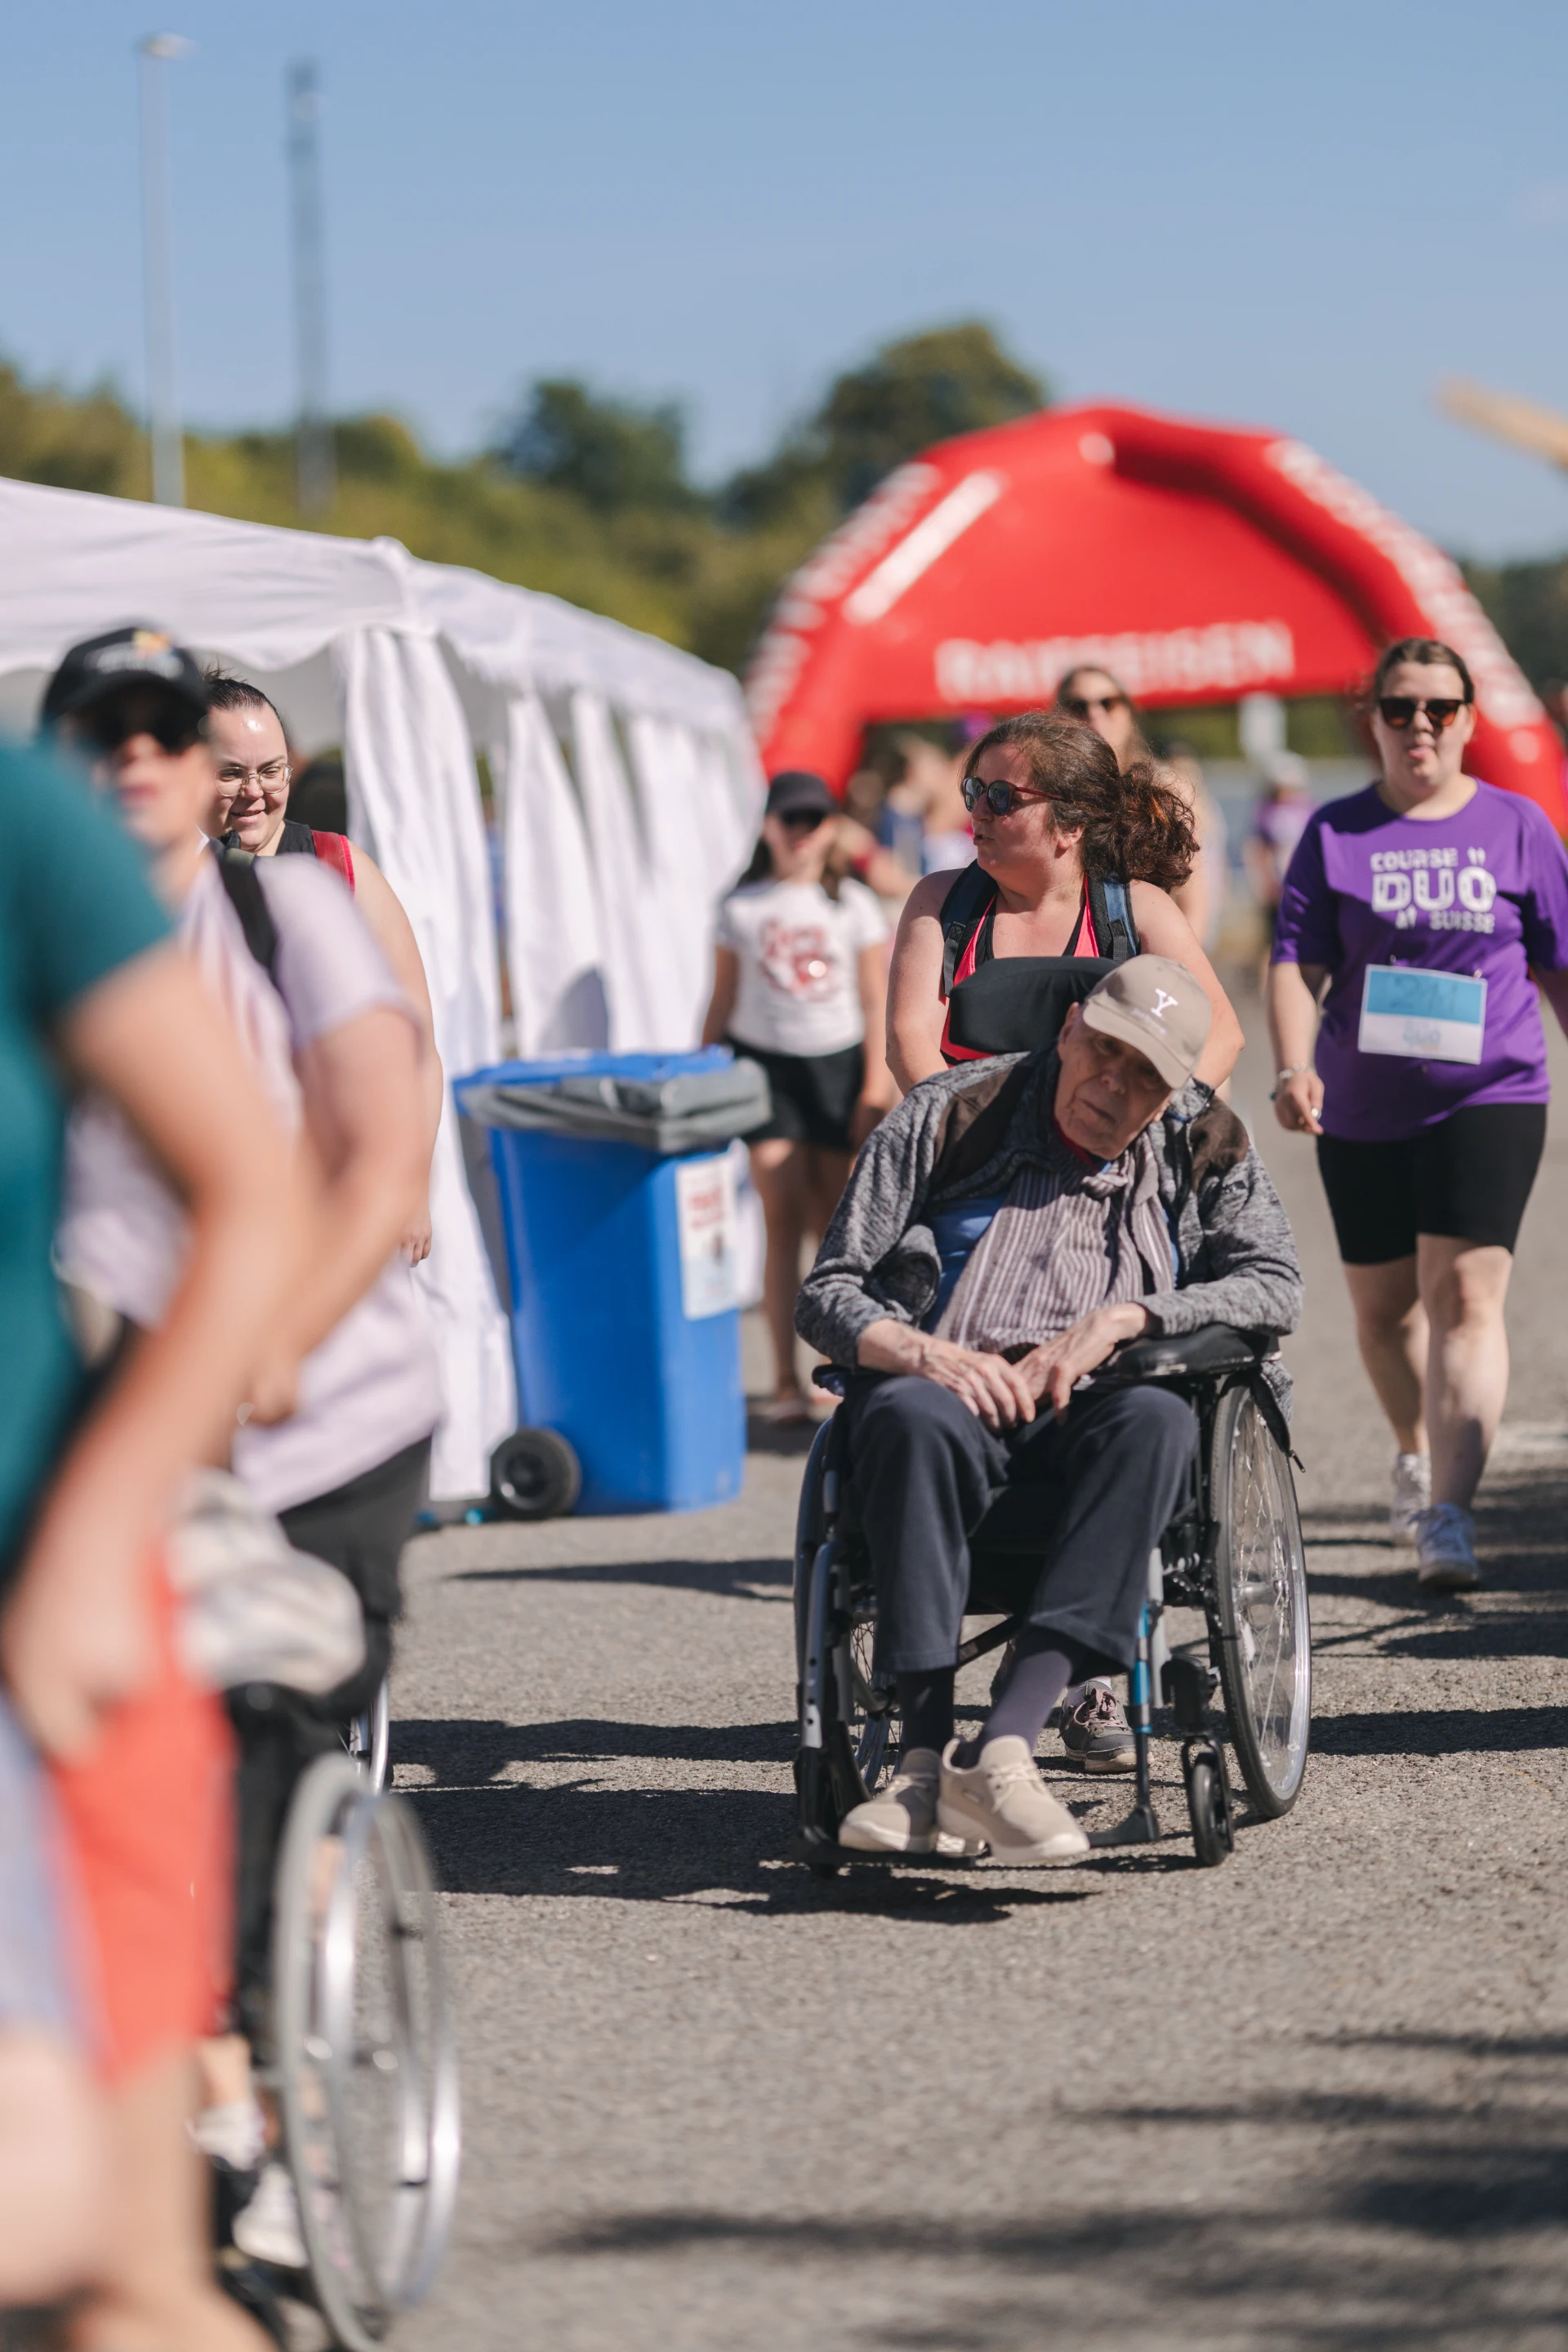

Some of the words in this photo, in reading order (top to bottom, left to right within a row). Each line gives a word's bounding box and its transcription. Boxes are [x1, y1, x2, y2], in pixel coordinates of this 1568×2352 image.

[1370, 848, 1459, 872] COURSE
[1371, 866, 1496, 913] DUO
[1151, 988, 1178, 1018] Y
